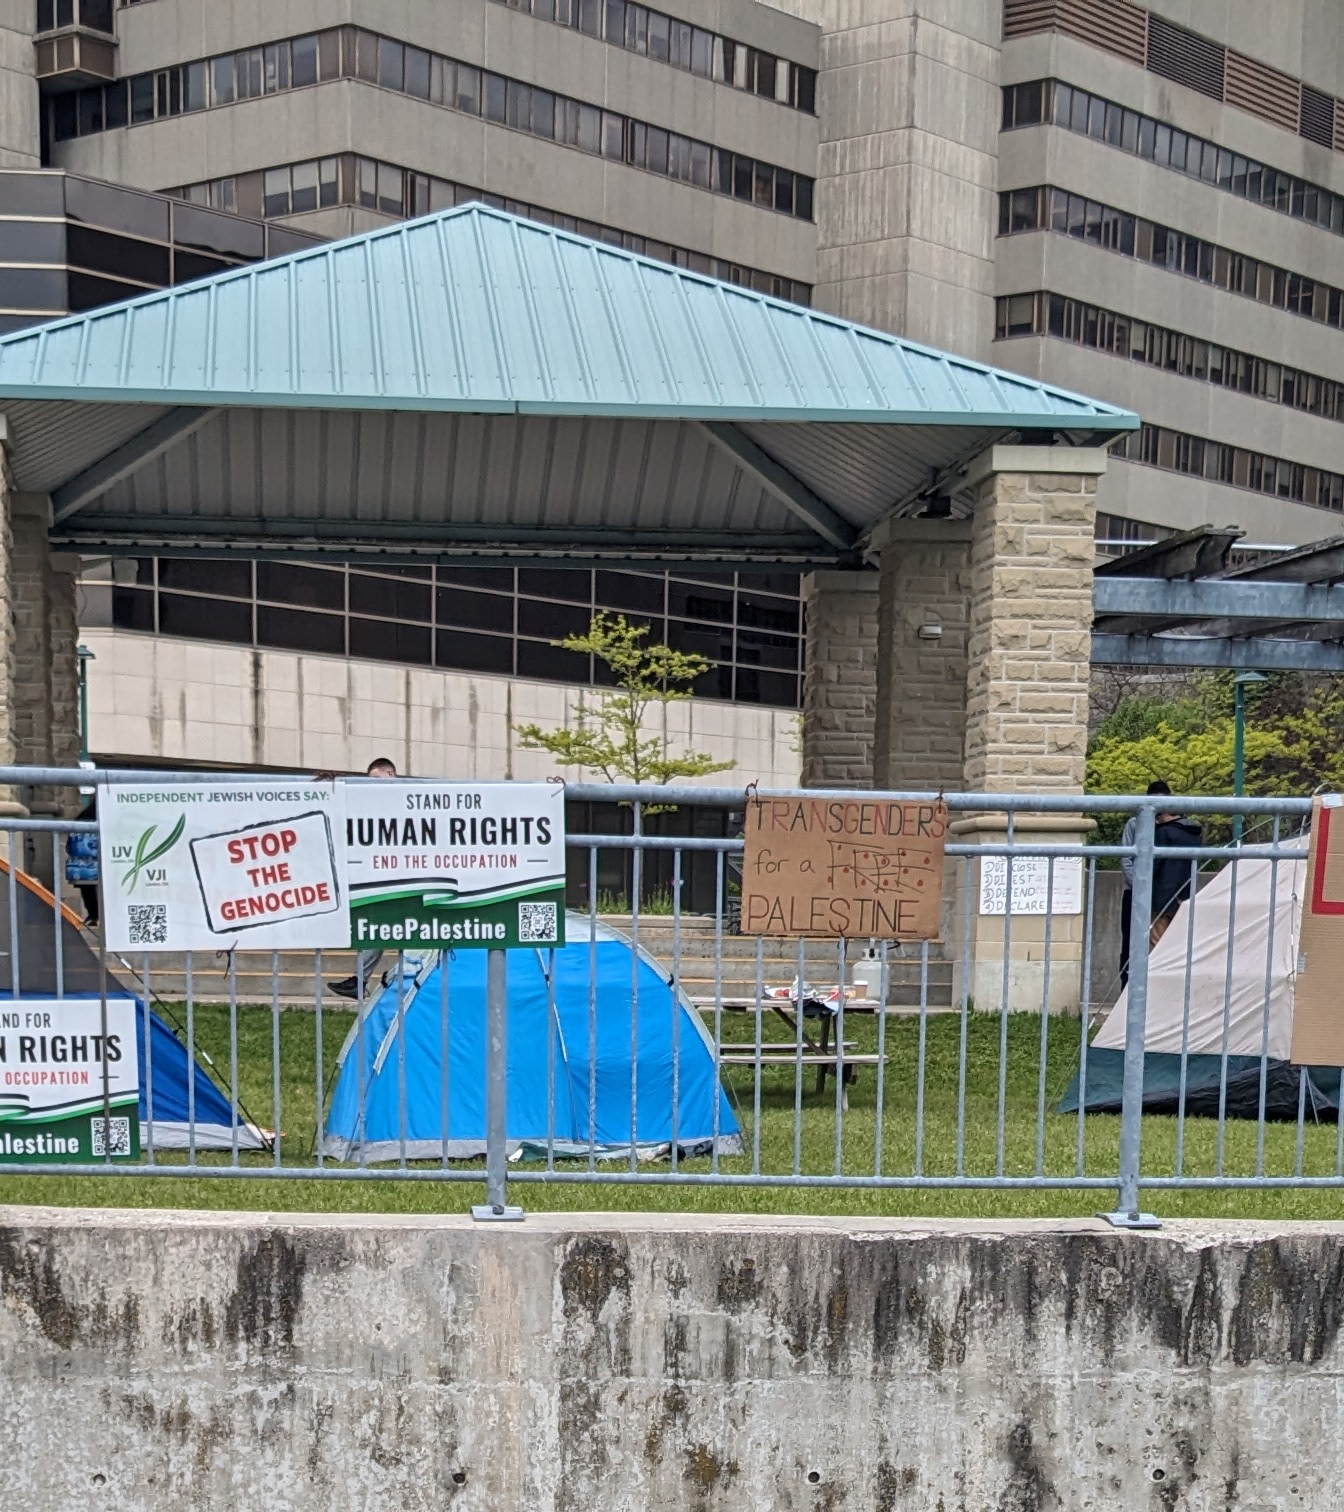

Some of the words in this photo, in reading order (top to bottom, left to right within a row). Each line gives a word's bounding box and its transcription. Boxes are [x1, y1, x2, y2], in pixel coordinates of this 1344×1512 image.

[116, 792, 204, 803] INDEPENDENT
[207, 792, 253, 803] JEWISH
[256, 792, 301, 802] VOICES
[303, 791, 331, 802] SAY:
[406, 793, 451, 810] STAND
[456, 793, 482, 810] FOR
[449, 816, 552, 846] RIGHTS
[752, 799, 947, 838] TRANSGENDERS
[111, 845, 133, 859] IJV
[227, 829, 297, 865] STOP
[372, 855, 398, 870] END
[401, 855, 428, 869] THE
[434, 854, 518, 869] OCCUPATION
[753, 849, 790, 874] for
[799, 859, 816, 874] a
[826, 839, 936, 894] FREE
[146, 869, 167, 881] VJI
[247, 863, 291, 888] THE
[220, 882, 331, 922] GENOCIDE
[748, 894, 920, 934] PALESTINE
[26, 1012, 52, 1028] FOR
[19, 1035, 123, 1063] RIGHTS
[5, 1071, 90, 1085] OCCUPATION
